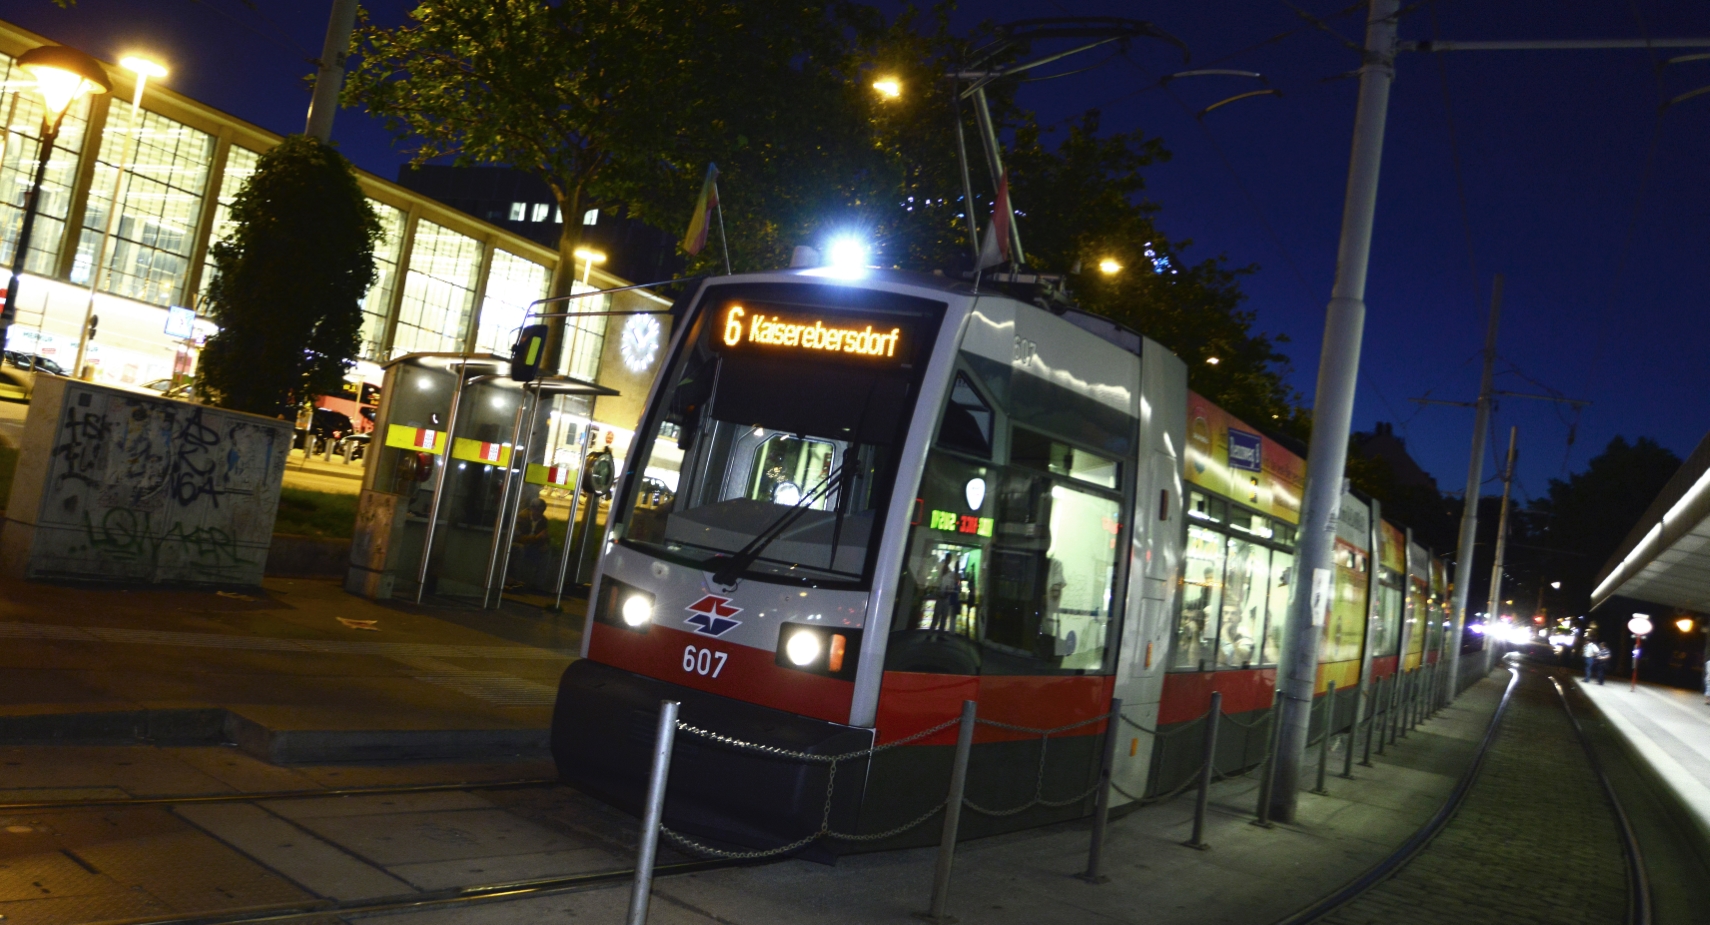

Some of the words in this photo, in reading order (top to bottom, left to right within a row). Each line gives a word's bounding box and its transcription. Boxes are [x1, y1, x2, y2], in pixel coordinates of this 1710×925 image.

[724, 305, 745, 347] 6
[748, 313, 900, 357] Kaiserebersdorf
[1013, 334, 1037, 367] 607
[683, 645, 728, 678] 607
